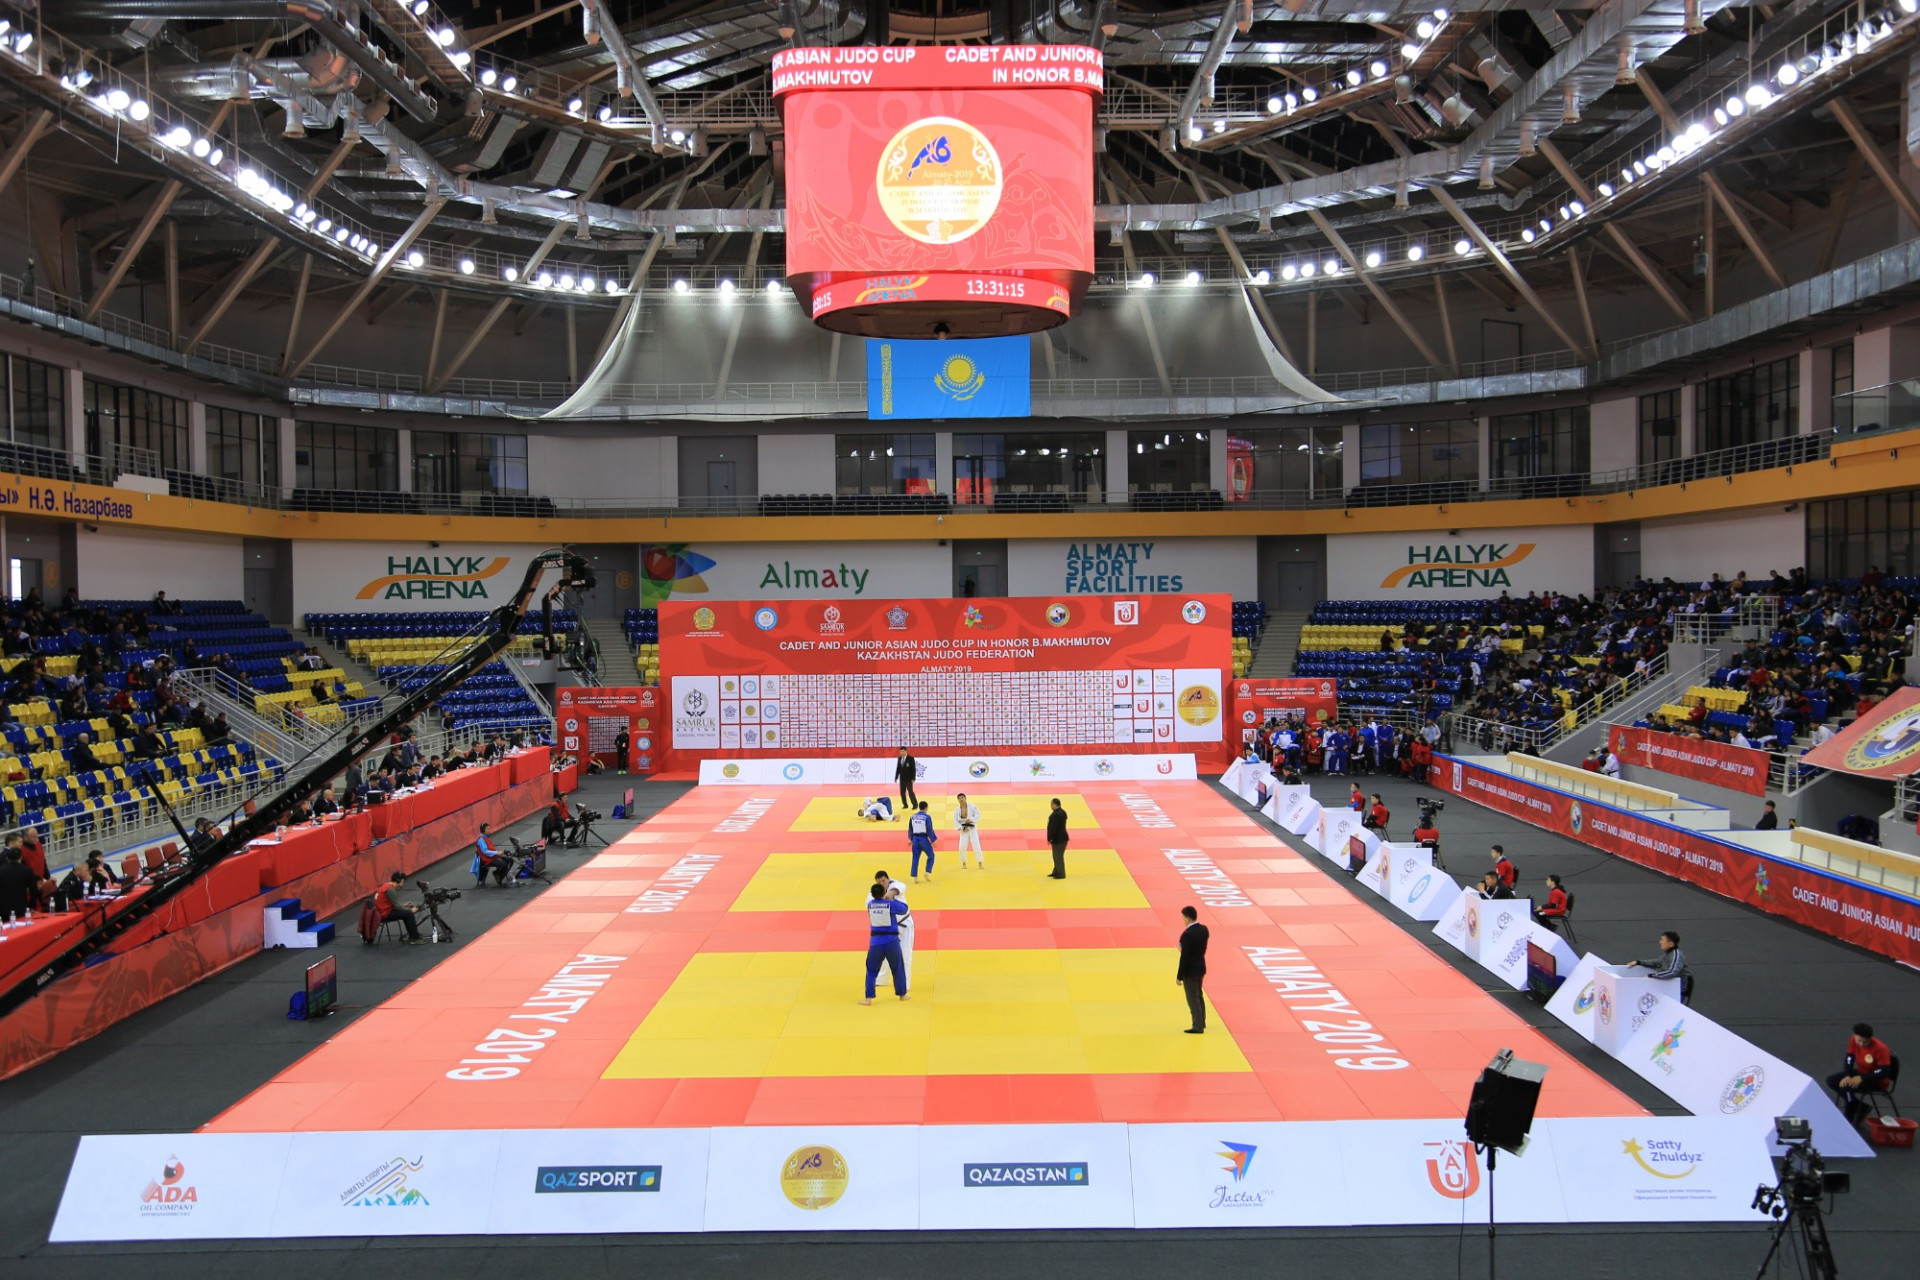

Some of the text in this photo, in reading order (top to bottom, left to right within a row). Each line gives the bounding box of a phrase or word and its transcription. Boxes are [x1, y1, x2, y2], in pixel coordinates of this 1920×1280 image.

[786, 49, 830, 66] ASIAN
[835, 48, 879, 63] JUDO
[882, 48, 916, 63] CUP
[945, 47, 999, 63] CADET
[1002, 47, 1036, 62] AND
[1040, 47, 1095, 64] JUNIOR
[993, 68, 1008, 83] IN
[1012, 67, 1070, 83] HONOR
[866, 277, 914, 290] HALYK
[967, 280, 1025, 298] 13:31:15
[866, 289, 916, 301] ARENA
[29, 487, 59, 511] Н.Ә.
[63, 491, 133, 520] Назарбаев
[1066, 542, 1155, 560] ALMATY
[1408, 543, 1509, 565] HALYK
[387, 556, 486, 576] HALYK
[1066, 559, 1137, 577] SPORT
[759, 561, 870, 594] Almaty
[1065, 575, 1184, 593] FACILITIES
[1407, 568, 1512, 588] ARENA
[384, 579, 488, 600] ARENA
[779, 637, 1112, 650] CADET AND JUNIOR ASIAN JUDO CUP IN HONOR B.MAKHMUTOV
[857, 649, 1034, 661] KAZAKHSTAN JUDO FEDERATION
[920, 665, 952, 673] ALMATY
[676, 718, 716, 726] SAMRUK
[1637, 742, 1650, 752] CADET
[1651, 744, 1661, 755] AND
[1661, 746, 1678, 758] JUNIOR
[1678, 750, 1692, 762] ASIAN
[1691, 753, 1705, 765] JUDO
[1706, 757, 1717, 768] CUP
[1721, 759, 1742, 775] ALMATY
[1742, 765, 1755, 777] 2019
[1591, 818, 1607, 832] CADET
[1607, 824, 1618, 836] AND
[1618, 827, 1636, 843] JUNIOR
[1636, 834, 1652, 848] ASIAN
[1653, 839, 1669, 854] JUDO
[1669, 844, 1681, 858] CUP
[1685, 850, 1709, 868] ALMATY
[1709, 859, 1724, 874] 2019
[624, 853, 723, 913] ALMATY 2019
[1160, 848, 1253, 907] ALMATY 2019
[1792, 886, 1819, 906] CADET
[1820, 896, 1839, 912] AND
[1839, 903, 1873, 925] JUNIOR
[1873, 915, 1903, 935] ASIAN
[446, 953, 628, 1081] ALMATY 2019
[1241, 945, 1411, 1071] ALMATY 2019
[1647, 1140, 1682, 1151] Satty
[1650, 1152, 1703, 1163] Zhuldyz
[340, 1162, 390, 1201] АЛМАТЫ СПОРТЫ
[543, 1171, 637, 1189] QAZSPORT
[969, 1167, 1067, 1183] QAZAQSTAN
[143, 1186, 198, 1203] ADA
